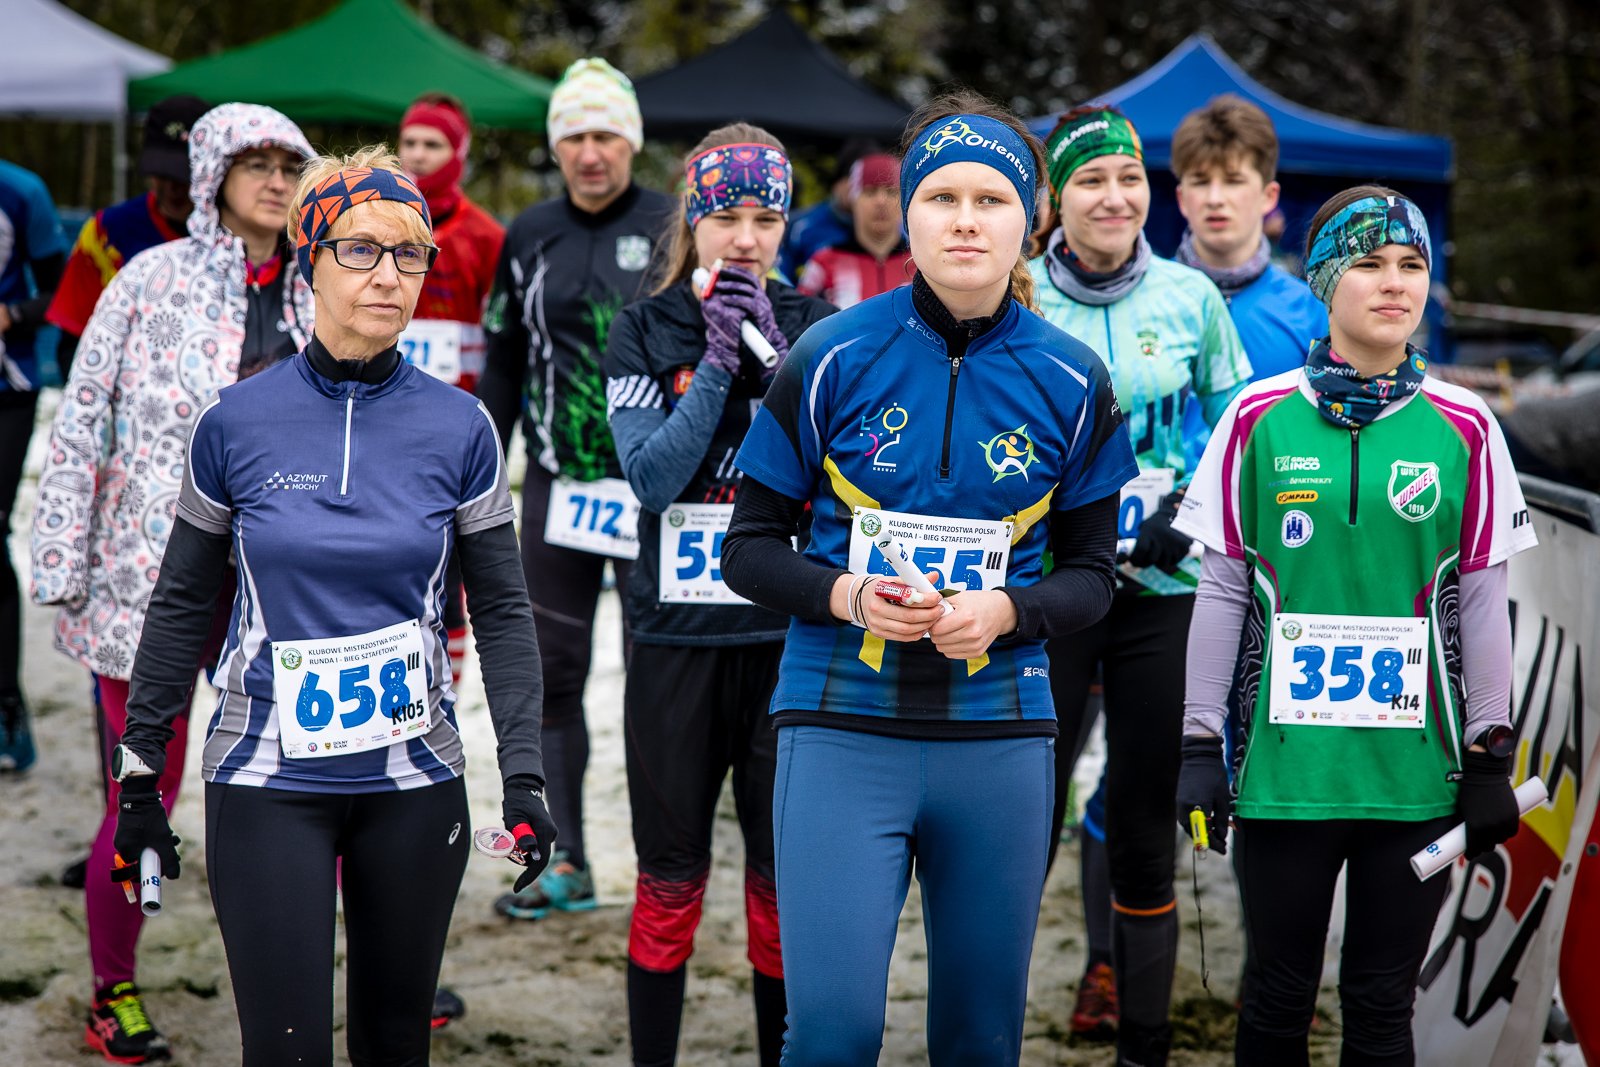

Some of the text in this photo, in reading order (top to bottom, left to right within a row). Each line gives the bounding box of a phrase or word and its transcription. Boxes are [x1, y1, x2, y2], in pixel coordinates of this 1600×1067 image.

[965, 134, 1030, 182] Orientus
[1290, 462, 1321, 471] INCO
[1400, 467, 1420, 477] WKS
[286, 474, 328, 483] AZYMUT
[292, 483, 320, 491] MOCHY
[1400, 470, 1433, 507] WAWEL
[1278, 492, 1315, 503] COMPASS
[569, 494, 624, 537] 712
[1408, 503, 1425, 515] 1919
[888, 520, 997, 536] KLUBOWE MISTRZOSTWA POLSKI
[923, 534, 939, 542] BIEG
[940, 535, 982, 544] SZTAFETOWY
[1343, 625, 1390, 633] MISTRZOSTWA
[308, 632, 408, 656] KLUBOWE MISTRZOSTWA POLSKI
[309, 655, 332, 665] RUNDA
[343, 653, 360, 662] BIEG
[361, 645, 399, 661] SZTAFETOWY
[1289, 645, 1404, 704] 358
[295, 657, 411, 732] 658
[1391, 694, 1420, 711] K14
[391, 699, 425, 726] K105
